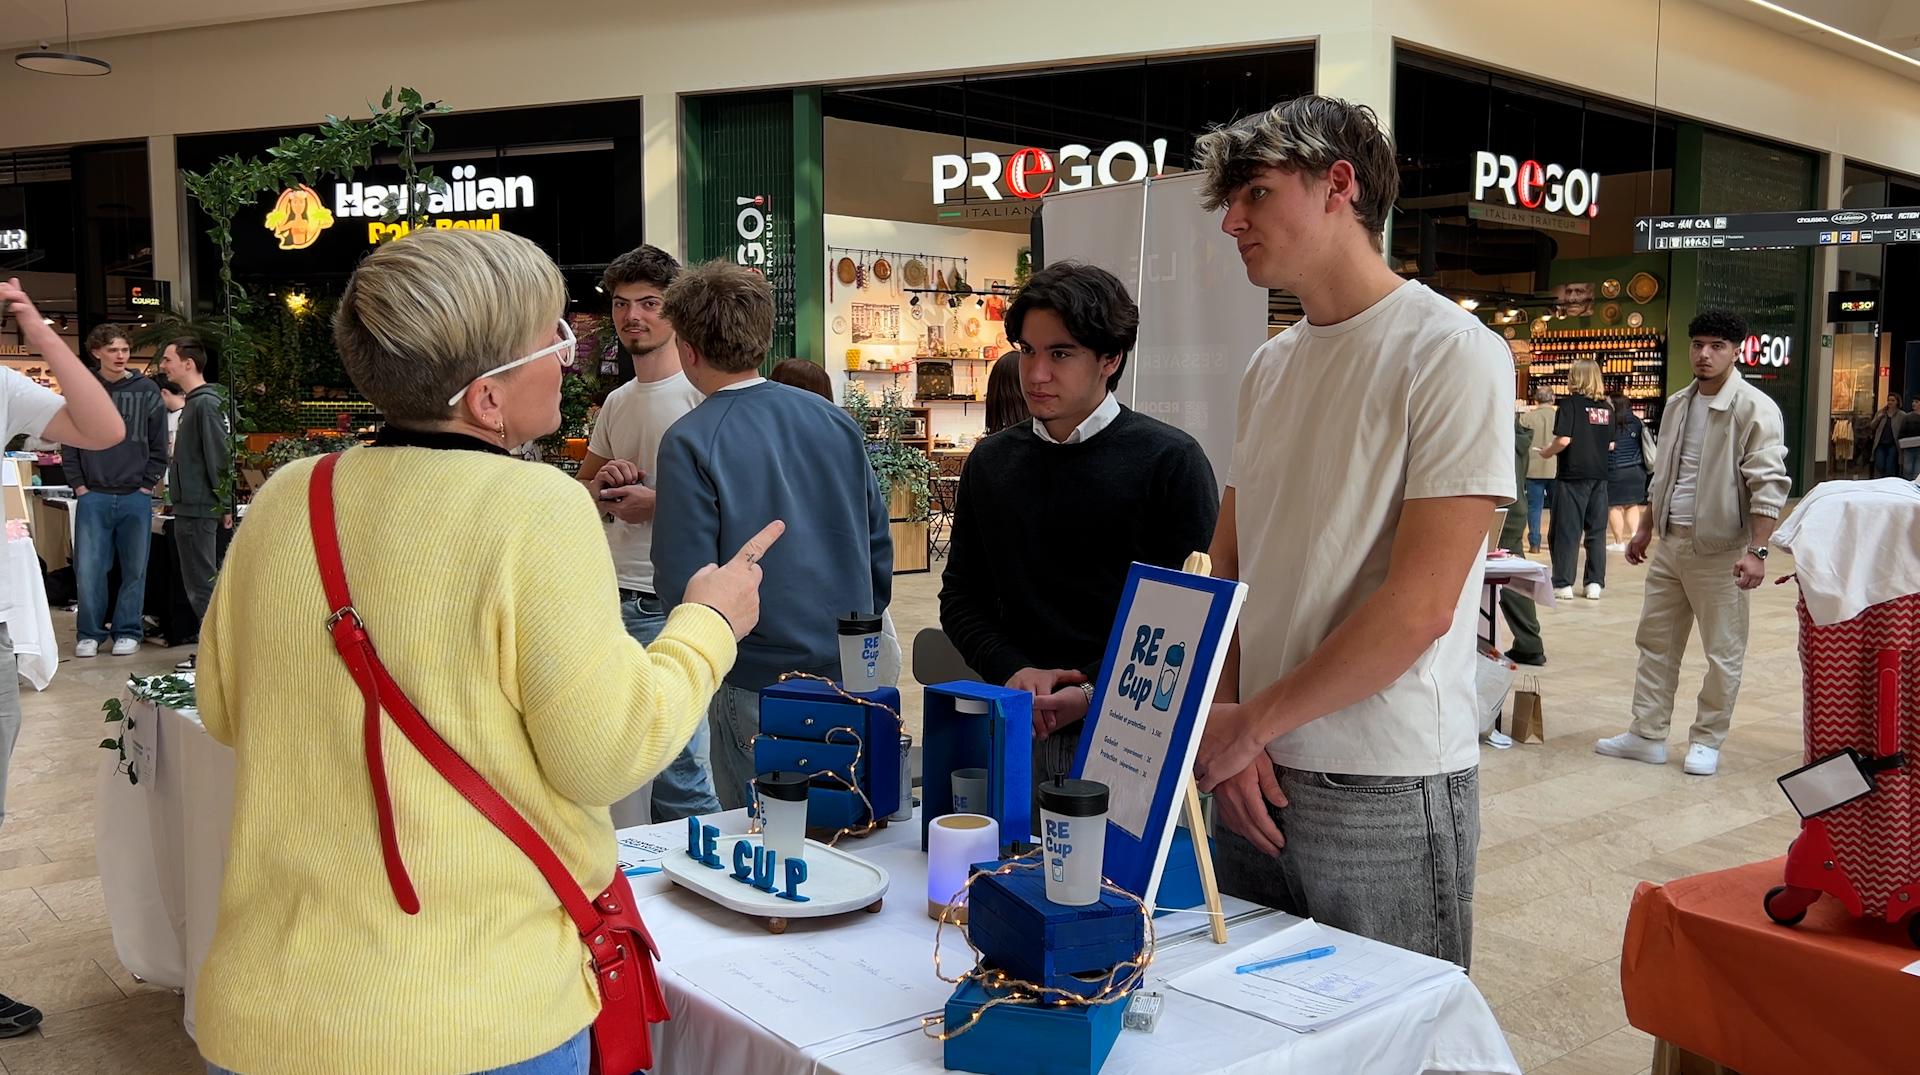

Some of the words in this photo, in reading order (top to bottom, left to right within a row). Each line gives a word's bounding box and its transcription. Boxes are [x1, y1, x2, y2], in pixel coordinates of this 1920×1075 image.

[965, 205, 1035, 218] ITALIAN
[1485, 208, 1526, 222] ITALIAN
[1531, 214, 1576, 229] TRAITEUR
[1822, 233, 1831, 241] P3
[1841, 233, 1851, 241] P2
[864, 636, 880, 649] RE
[1131, 625, 1165, 666] RE
[1118, 663, 1153, 711] Cup
[1127, 719, 1147, 731] protection
[1046, 819, 1070, 839] RE
[1046, 837, 1072, 858] Cup
